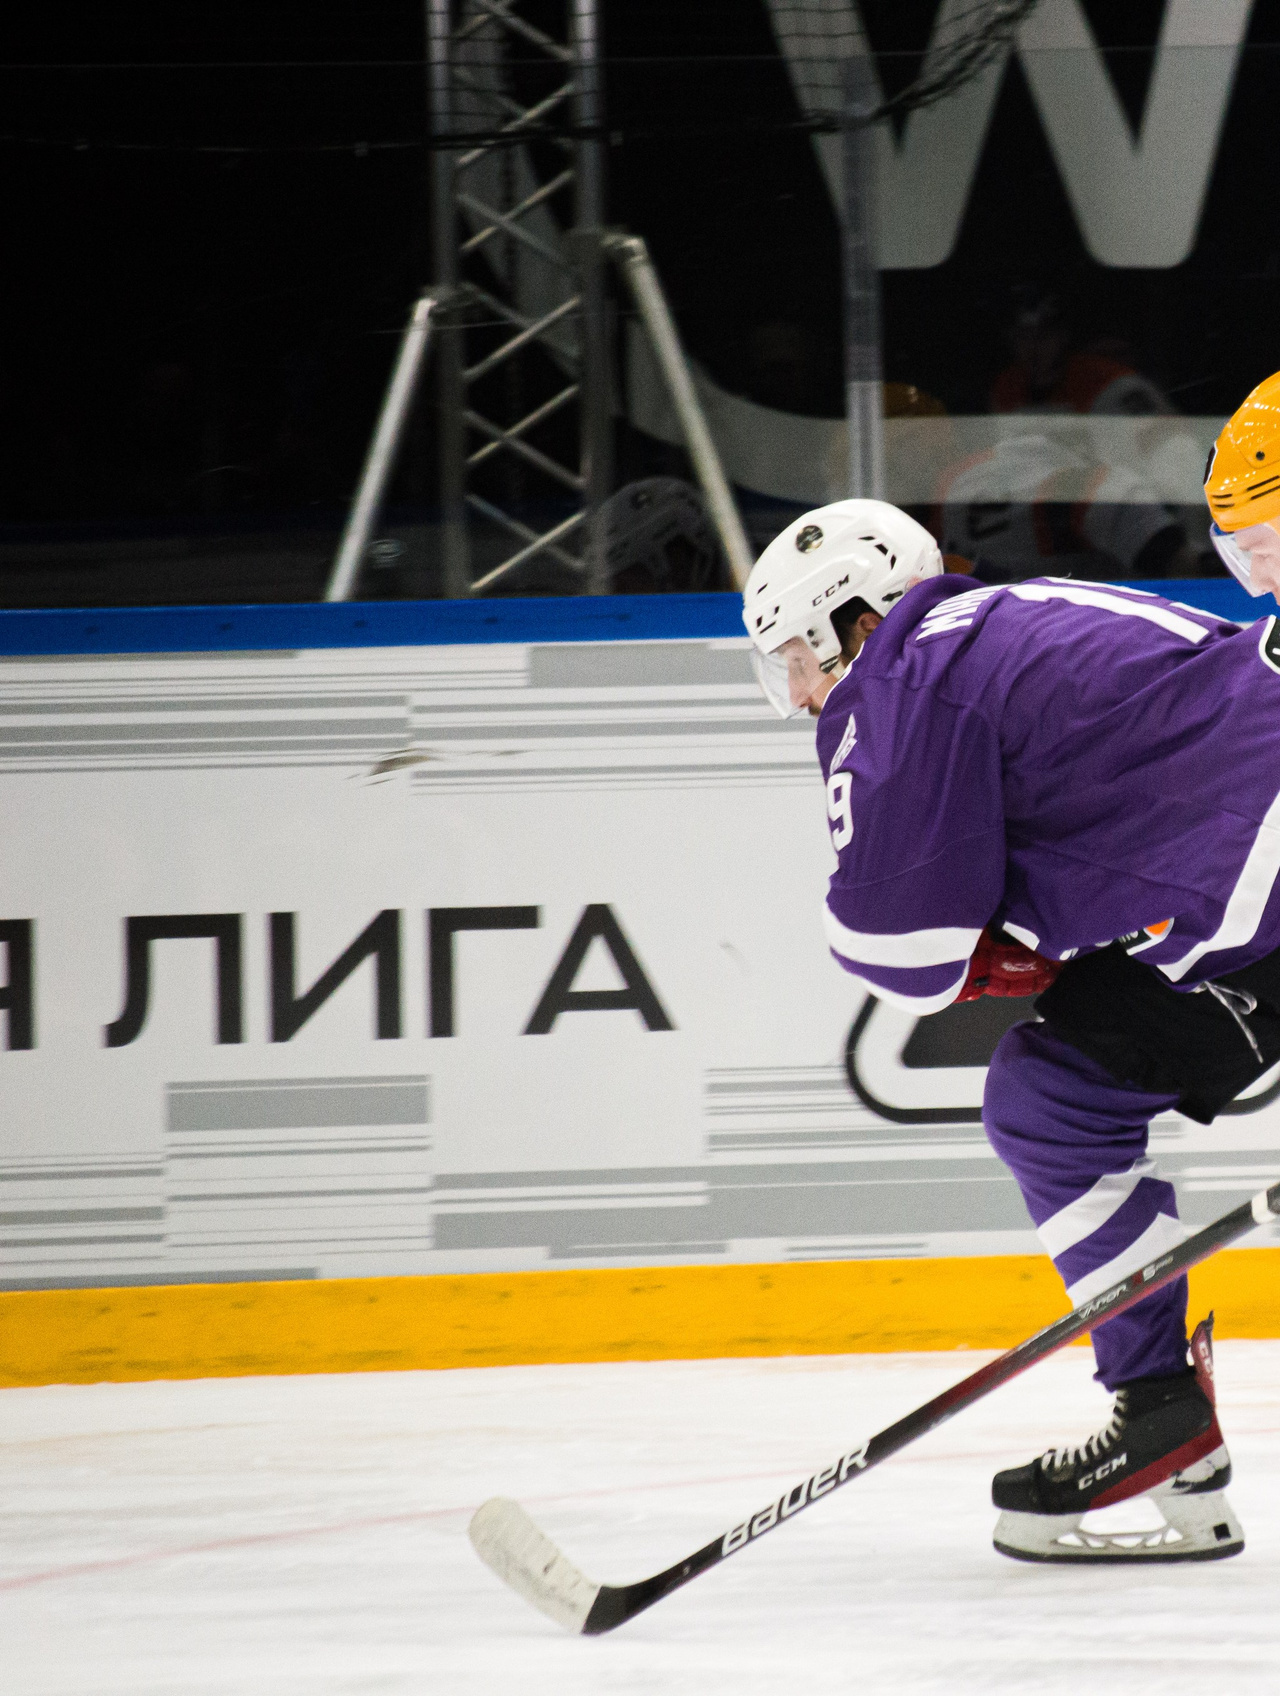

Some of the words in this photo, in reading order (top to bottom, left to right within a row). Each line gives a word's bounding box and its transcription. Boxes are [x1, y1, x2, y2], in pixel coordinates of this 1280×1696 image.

[812, 573, 850, 607] CCM
[102, 902, 677, 1049] ЛИГА
[721, 1439, 871, 1558] BAUER
[1078, 1452, 1128, 1490] CCM
